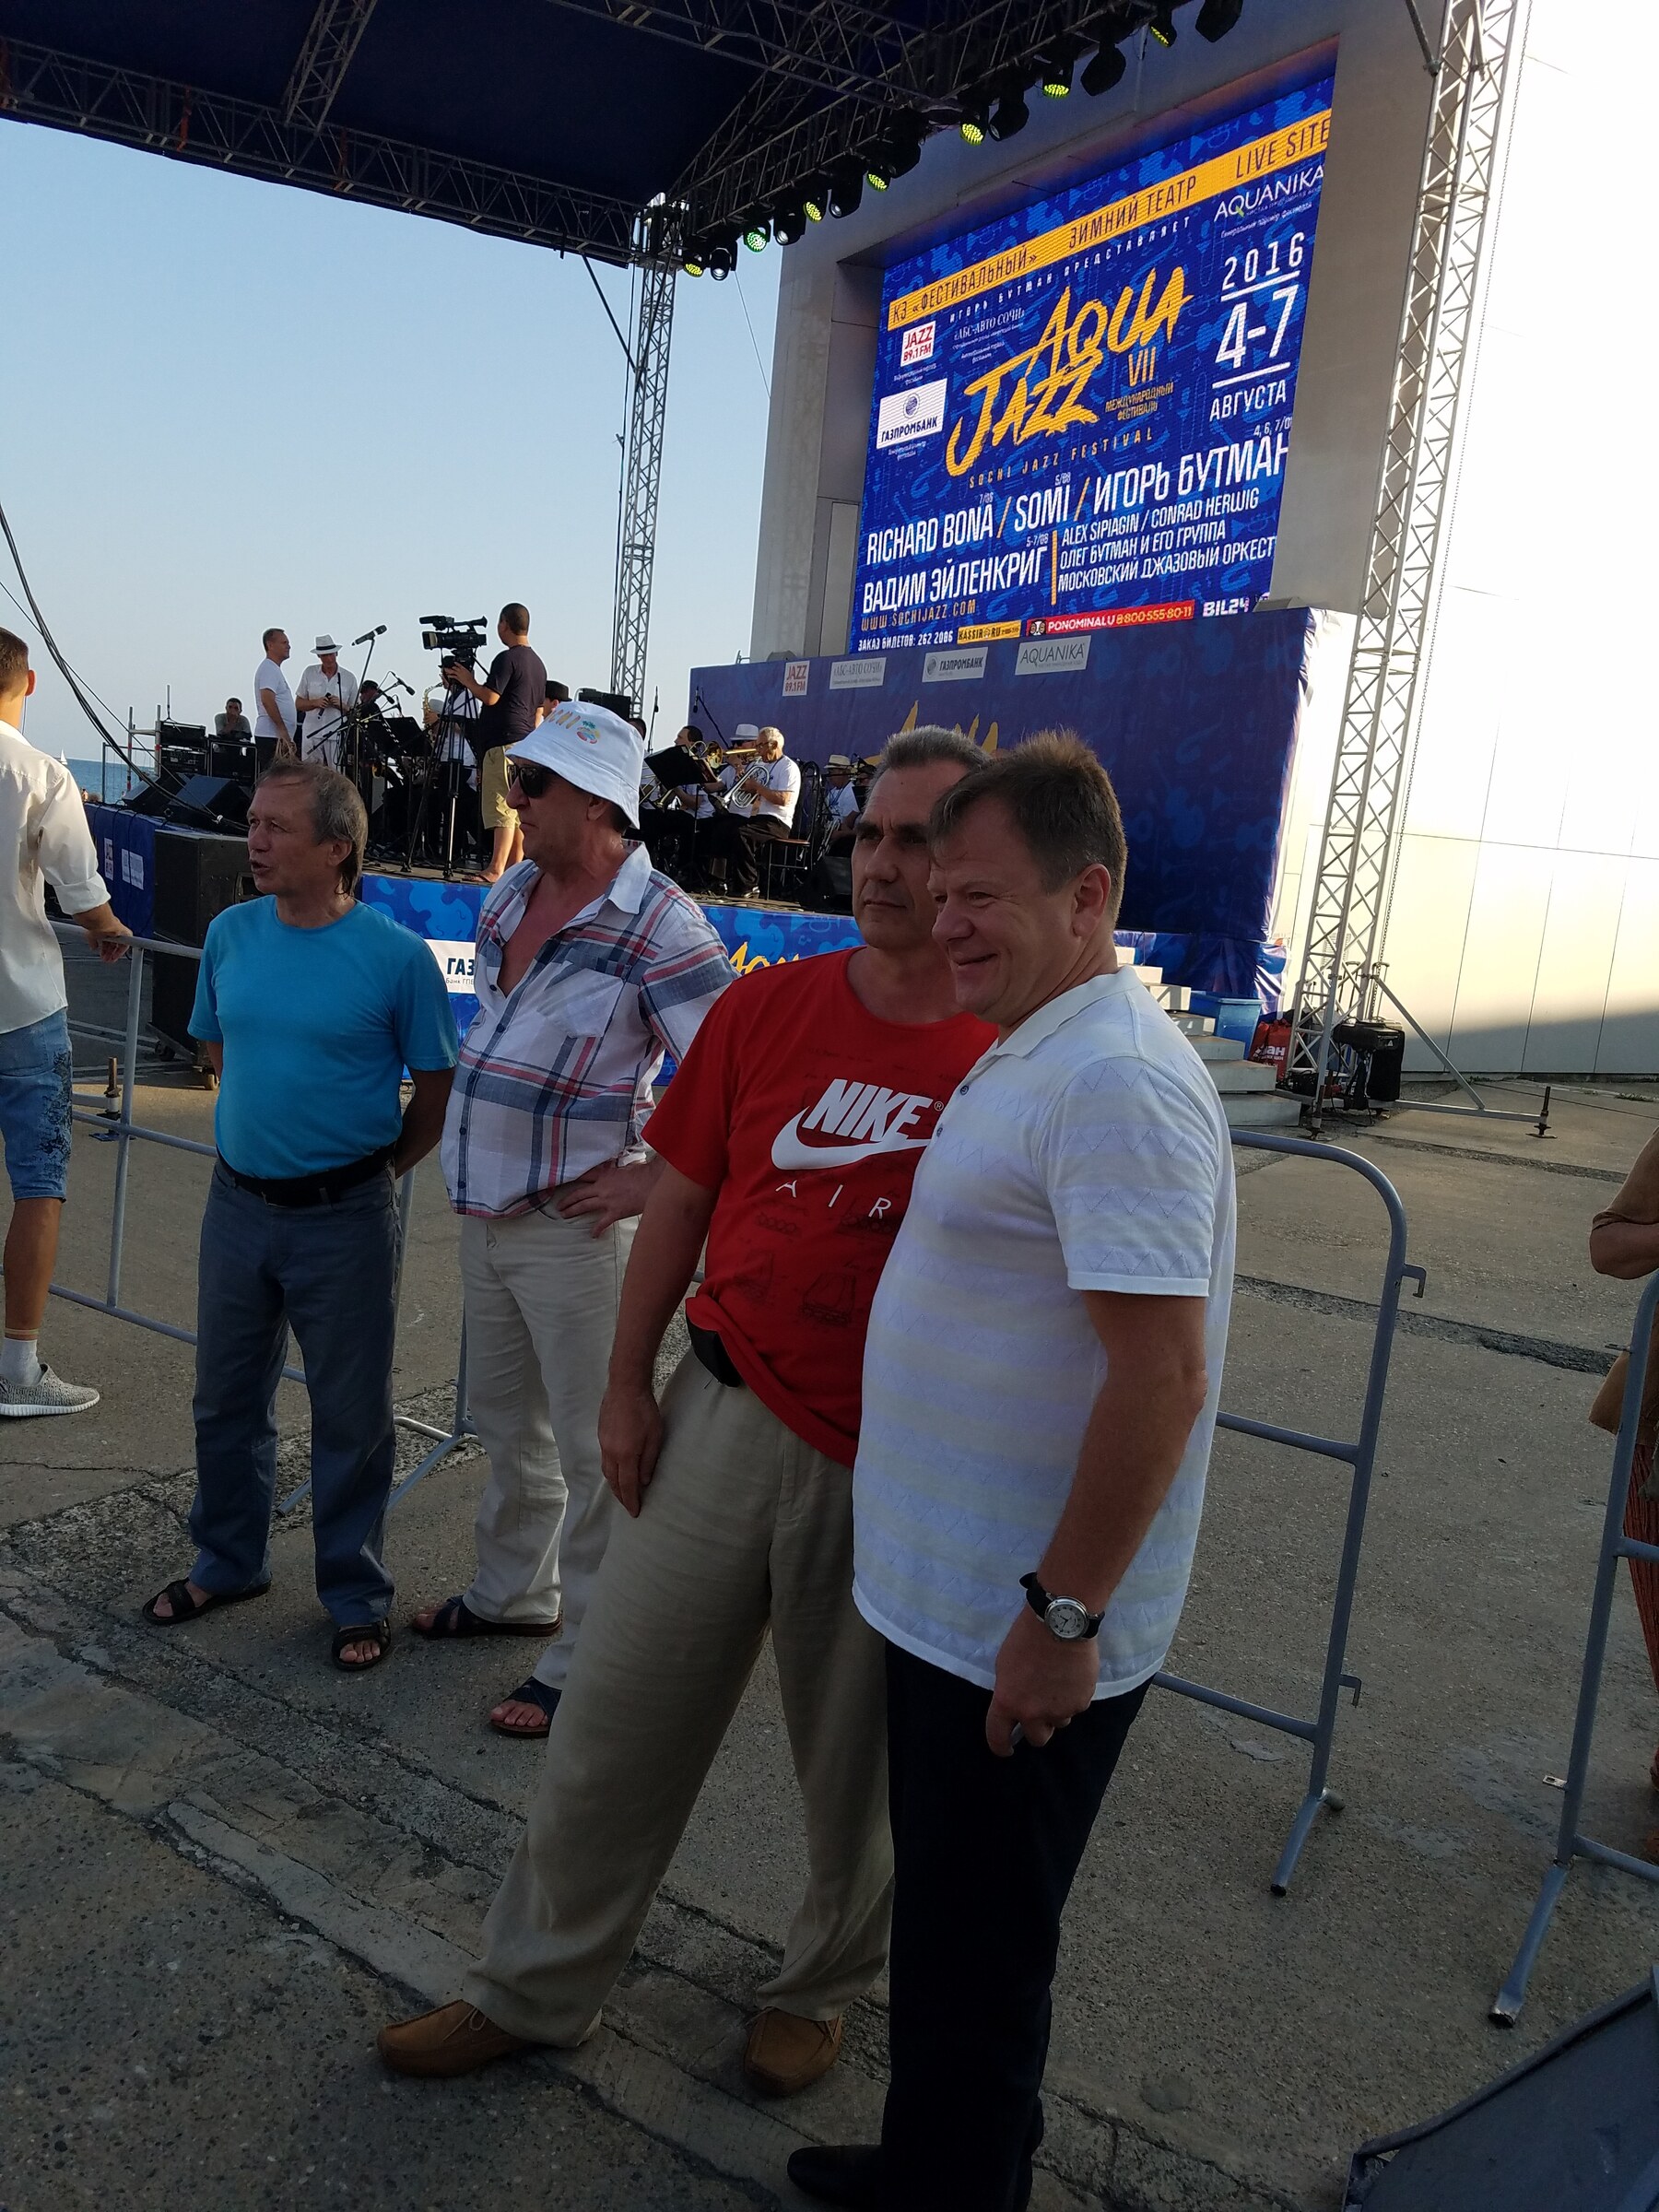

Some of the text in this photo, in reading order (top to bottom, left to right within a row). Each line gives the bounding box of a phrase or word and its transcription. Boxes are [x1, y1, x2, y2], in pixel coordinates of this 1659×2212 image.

[1236, 117, 1331, 179] LIVE SITE
[1069, 197, 1138, 248] ЗИМНИЙ
[1147, 175, 1196, 218] ТЕАТР
[1214, 165, 1324, 222] AQUANIKA
[893, 245, 1037, 323] КЗ «ФЕСТИВАЛЬНЫЙ»
[1222, 231, 1305, 291] 2016
[949, 300, 988, 324] ИГОРЬ
[998, 273, 1053, 303] БУТМАН
[1025, 266, 1194, 377] AQUA
[1215, 284, 1299, 369] 4-7
[905, 325, 934, 348] JAZZ
[1128, 347, 1156, 386] VII
[881, 416, 938, 442] ГАЗПРОМБАНК
[946, 347, 1102, 477] JAZZ
[1209, 380, 1286, 422] АВГУСТА
[1275, 416, 1293, 431] 7/0
[970, 427, 1152, 488] SOCHI JAZZ FESTIVAL
[866, 518, 938, 565] RICHARD
[943, 503, 994, 548] BONA
[1014, 484, 1070, 532] SOMI
[1093, 462, 1170, 515] ИГОРЬ
[1062, 524, 1088, 547] ALEX
[1090, 512, 1139, 541] SIPIAGIN
[1153, 500, 1201, 528] CONRAD
[1205, 487, 1259, 518] HERWIG
[1057, 535, 1277, 593] МОСКОВСКИЙ ДЖАЗОВЫЙ ОРКЕСТ
[1060, 519, 1226, 570] ОЛЕГ БУТМАН И ЕГО ГРУППА
[863, 546, 1047, 615] ВАДИМ ЭЙЛЕНКРИГ
[786, 665, 807, 680] JAZZ
[857, 637, 881, 652] ЗАКАЗ
[939, 656, 983, 672] ГАЗПРОМБАНК
[1020, 643, 1085, 665] AQUANIKA
[801, 1078, 933, 1143] NIKE
[775, 1180, 892, 1220] AIR
